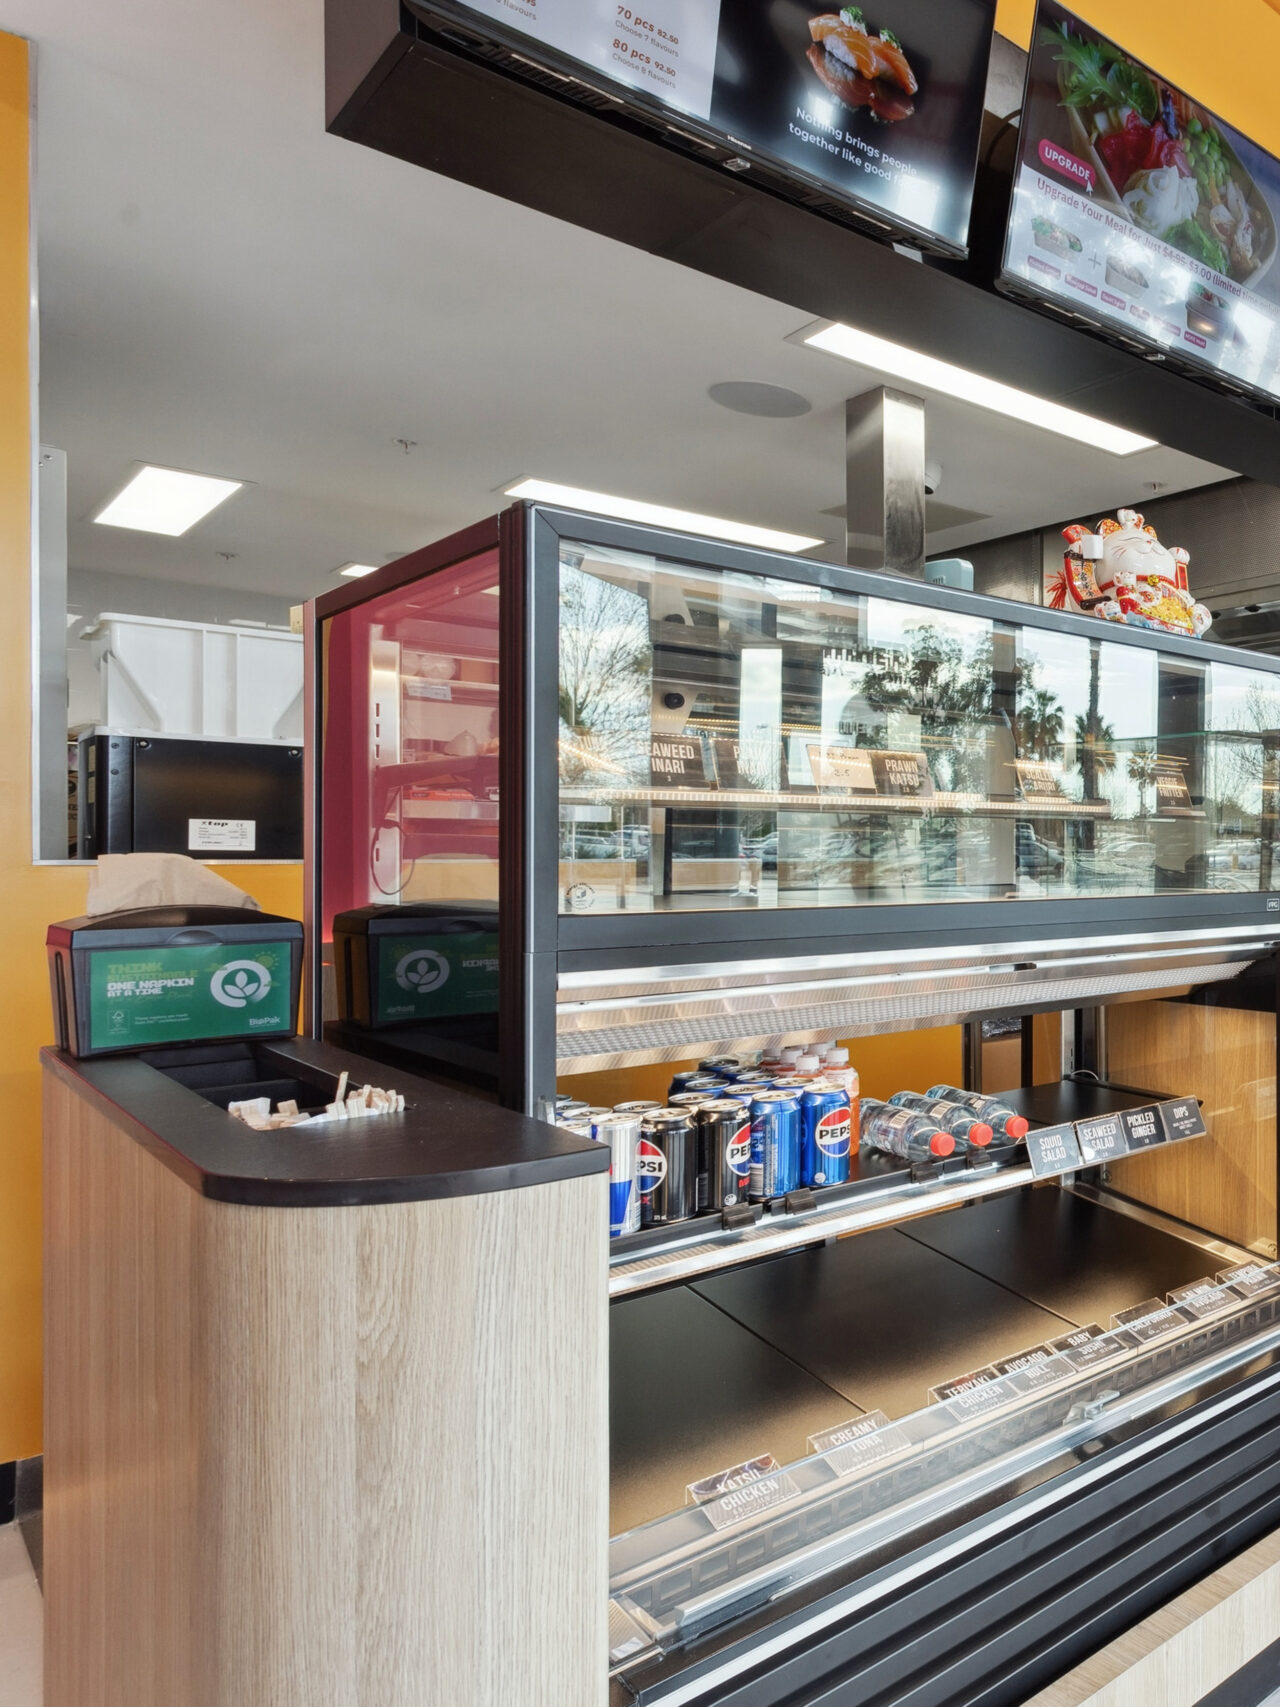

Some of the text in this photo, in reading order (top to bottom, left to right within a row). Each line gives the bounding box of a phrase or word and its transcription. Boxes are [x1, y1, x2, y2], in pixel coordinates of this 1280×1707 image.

[617, 5, 679, 45] 70 pcs 82.50
[615, 19, 644, 39] Choose
[650, 37, 679, 57] flavours
[612, 39, 676, 77] 80 pcs 92.50
[612, 53, 640, 71] Choose
[647, 70, 676, 89] flavours
[796, 106, 918, 178] Nothing brings people
[788, 121, 892, 182] together like good
[1044, 146, 1090, 181] UPGRADE
[1037, 177, 1079, 210] Upgrade
[1081, 202, 1103, 222] Your
[1105, 215, 1127, 236] Meal
[1129, 227, 1143, 242] for
[1144, 237, 1161, 254] Just
[1188, 261, 1212, 281] $3.00
[1212, 275, 1241, 297] (limited
[651, 757, 685, 774] INARI
[885, 759, 919, 773] PRAWN
[889, 772, 920, 786] KATSU
[1159, 786, 1184, 798] FRITTER
[107, 977, 195, 991] ONE NAPKIN
[107, 990, 122, 998] AT
[124, 989, 133, 997] A
[249, 1016, 281, 1026] BioPak
[1126, 1111, 1155, 1127] PICKLED
[1173, 1105, 1189, 1120] DIPS
[1082, 1122, 1117, 1141] SEAWEED
[1131, 1124, 1156, 1140] GINGER
[1039, 1133, 1063, 1151] SQUID
[1091, 1136, 1115, 1152] SALAD
[1041, 1146, 1067, 1164] SALAD
[1181, 1283, 1213, 1299] SALMON
[1192, 1290, 1227, 1309] AVOCADO
[1067, 1329, 1093, 1347] BABY
[1078, 1340, 1107, 1355] SUSHI
[1004, 1350, 1049, 1375] AVOCADO
[1023, 1364, 1051, 1379] ROLL
[943, 1373, 993, 1399] TERIYAKI
[959, 1384, 1005, 1409] CHICKEN
[830, 1419, 879, 1446] CREAMY
[850, 1434, 883, 1453] TUNA
[715, 1468, 762, 1494] KATSU
[719, 1478, 780, 1511] CHICKEN
